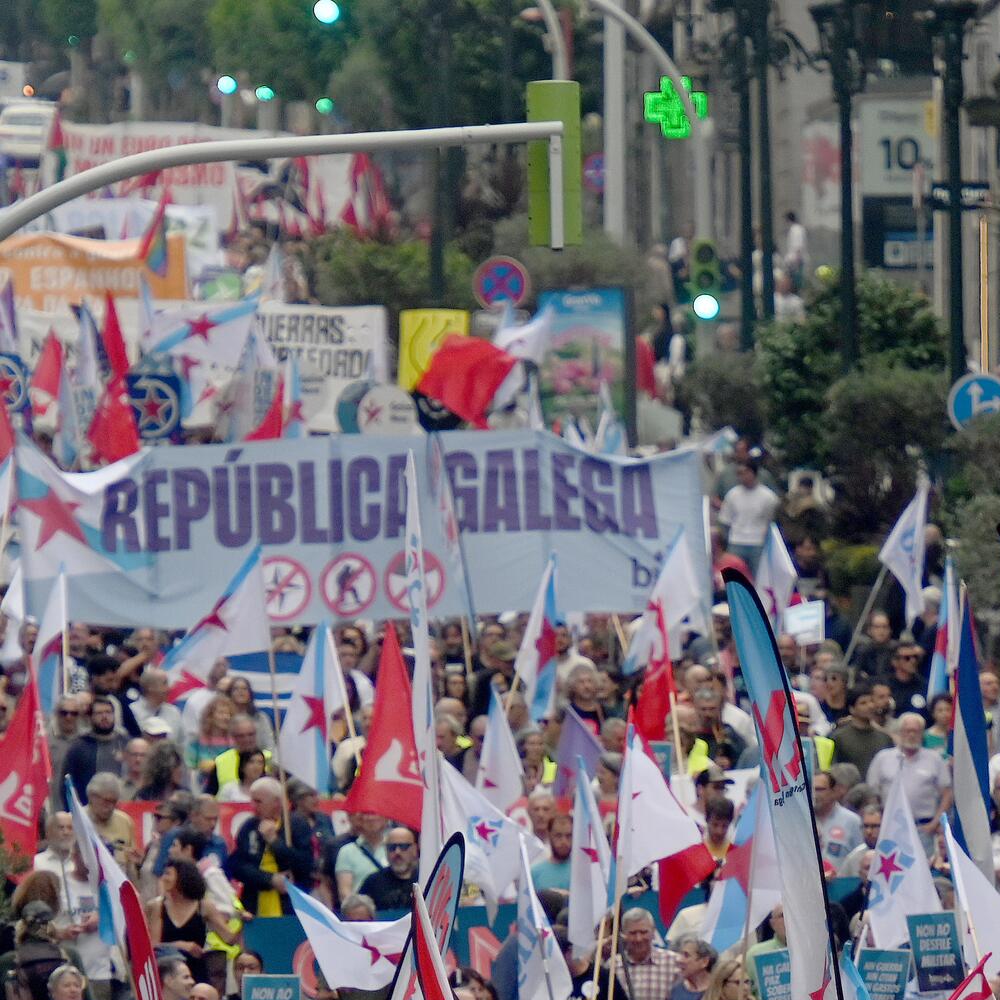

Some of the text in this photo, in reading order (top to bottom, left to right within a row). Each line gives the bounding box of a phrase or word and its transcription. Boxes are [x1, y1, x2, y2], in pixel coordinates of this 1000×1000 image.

[879, 137, 909, 171] 10
[101, 448, 658, 553] REPÚBLICA GALEGA
[916, 923, 950, 937] NON AO
[920, 938, 951, 951] DESFILE
[921, 953, 956, 968] MILITAR
[251, 987, 293, 1000] NON AO
